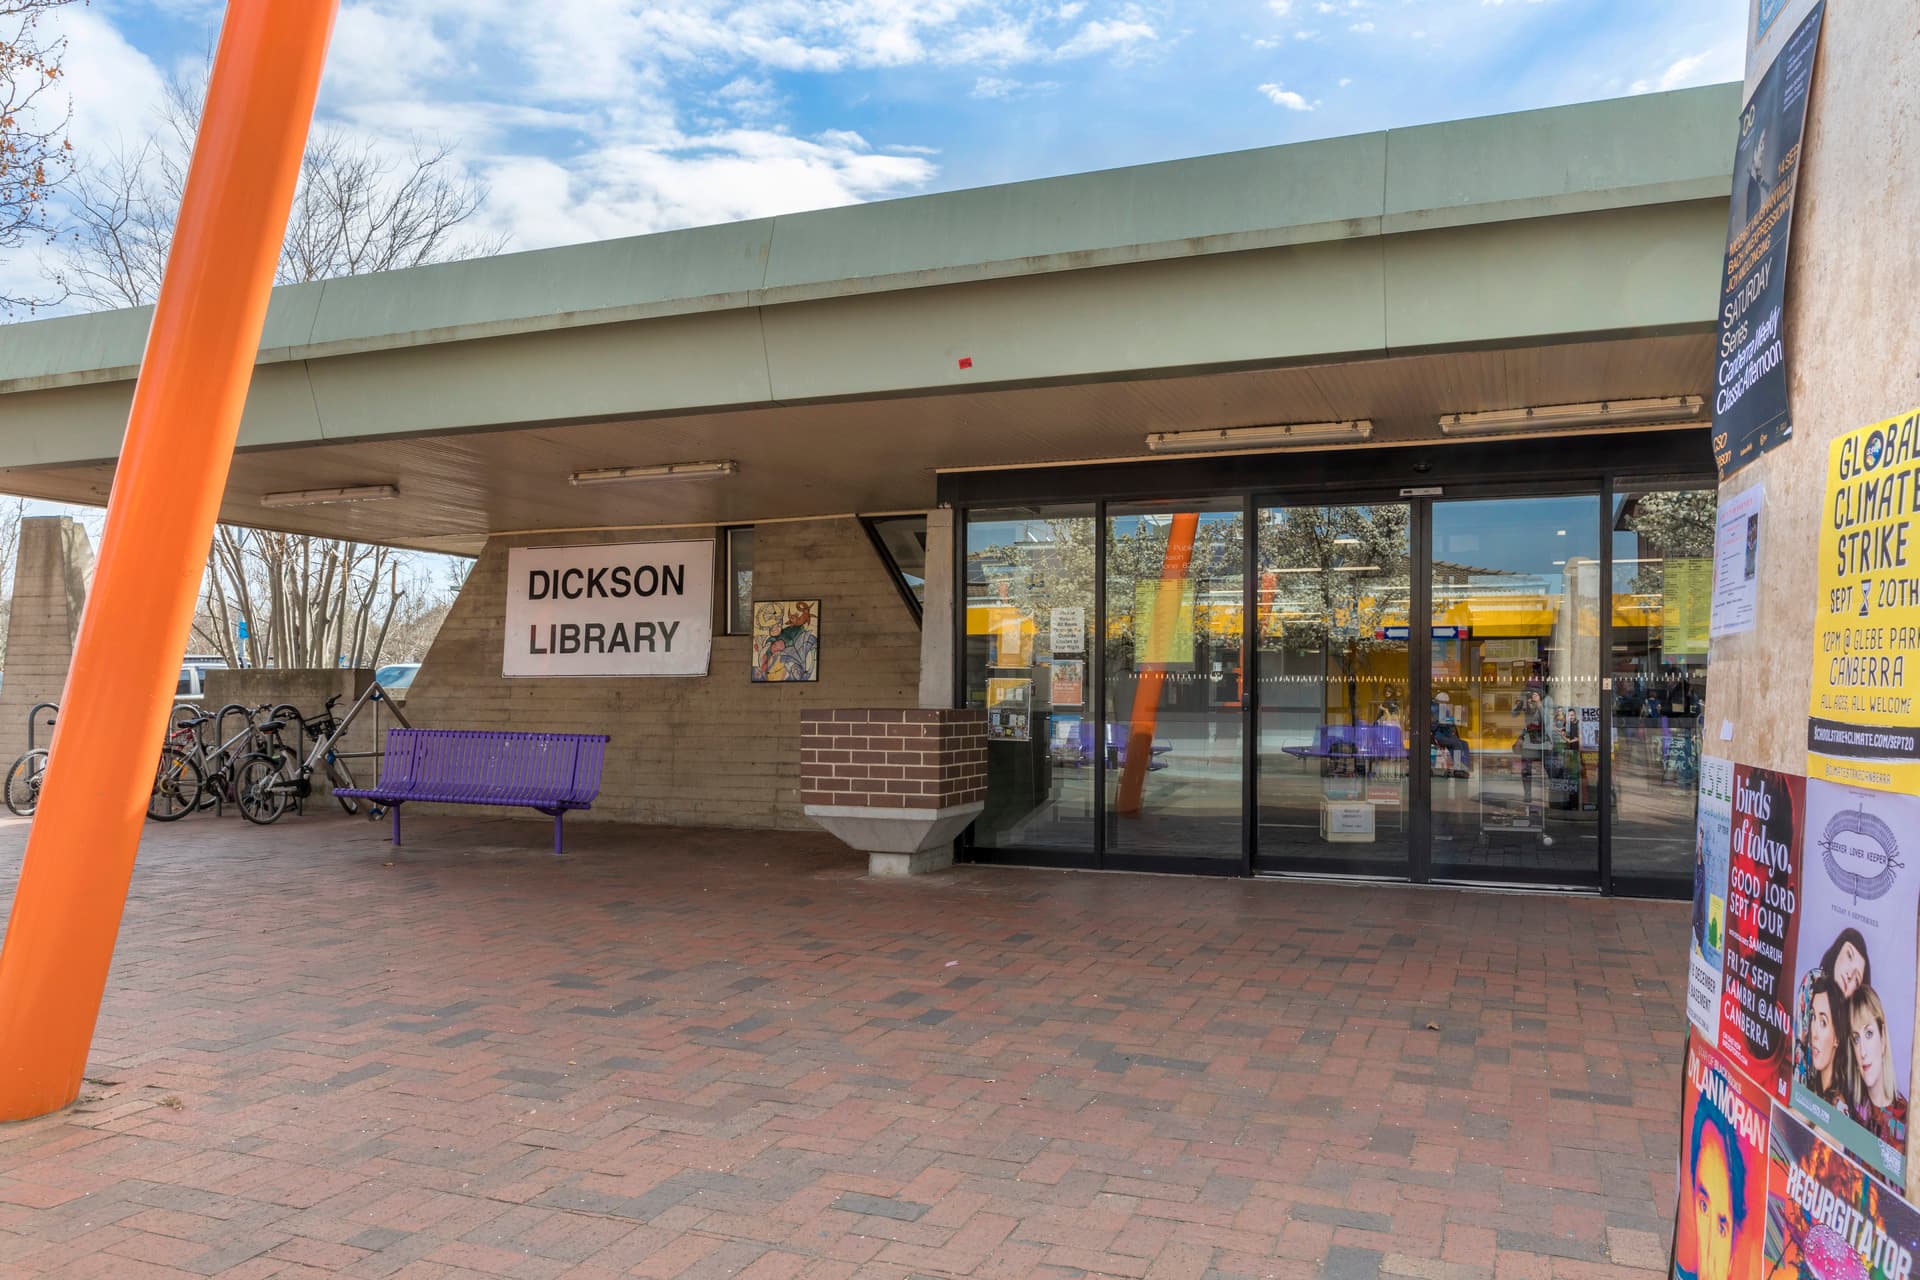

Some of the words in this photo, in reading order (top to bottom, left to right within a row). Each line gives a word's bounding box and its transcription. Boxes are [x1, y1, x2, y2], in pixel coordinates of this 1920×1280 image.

[1723, 257, 1772, 329] SATURDAY
[1718, 338, 1754, 387] Canberra
[1753, 305, 1781, 350] Weekly
[1721, 319, 1749, 357] Series
[1716, 373, 1745, 415] Classic
[1743, 340, 1783, 388] Afternoon
[1839, 413, 1920, 480] GLOBAL
[1837, 521, 1909, 577] STRIKE
[529, 564, 685, 601] DICKSON
[1830, 586, 1853, 614] SEPT
[1878, 578, 1920, 608] 20TH
[530, 621, 680, 655] LIBRARY
[1823, 631, 1841, 652] 12PM
[1844, 628, 1851, 655] @
[1854, 628, 1884, 650] GLEBE
[1830, 655, 1903, 688] CANBERRA
[1821, 694, 1832, 709] ALL
[1851, 695, 1866, 712] ALL
[1869, 697, 1912, 714] WELCOME
[1735, 775, 1771, 821] birds
[1733, 818, 1749, 856] of
[1748, 825, 1793, 878] tokyo.
[1830, 842, 1847, 854] SEEKER
[1849, 846, 1864, 859] LOVER
[1866, 851, 1887, 865] KEEPER
[1731, 866, 1760, 899] GOOD
[1765, 880, 1795, 914] LORD
[1729, 891, 1749, 921] SEPT
[1752, 899, 1784, 939] TOUR
[1727, 949, 1738, 973] FRI
[1740, 958, 1750, 980] 27
[1751, 965, 1774, 995] SEPT
[1748, 935, 1783, 965] SAMSARUH
[1724, 1000, 1769, 1051] CANBERRA
[1725, 975, 1755, 1013] KAMBRI
[1757, 998, 1790, 1035] @ANU
[1688, 1047, 1719, 1107] DYLAN
[1718, 1080, 1767, 1155] MORAN
[1786, 1161, 1913, 1280] REGURGITATOR
